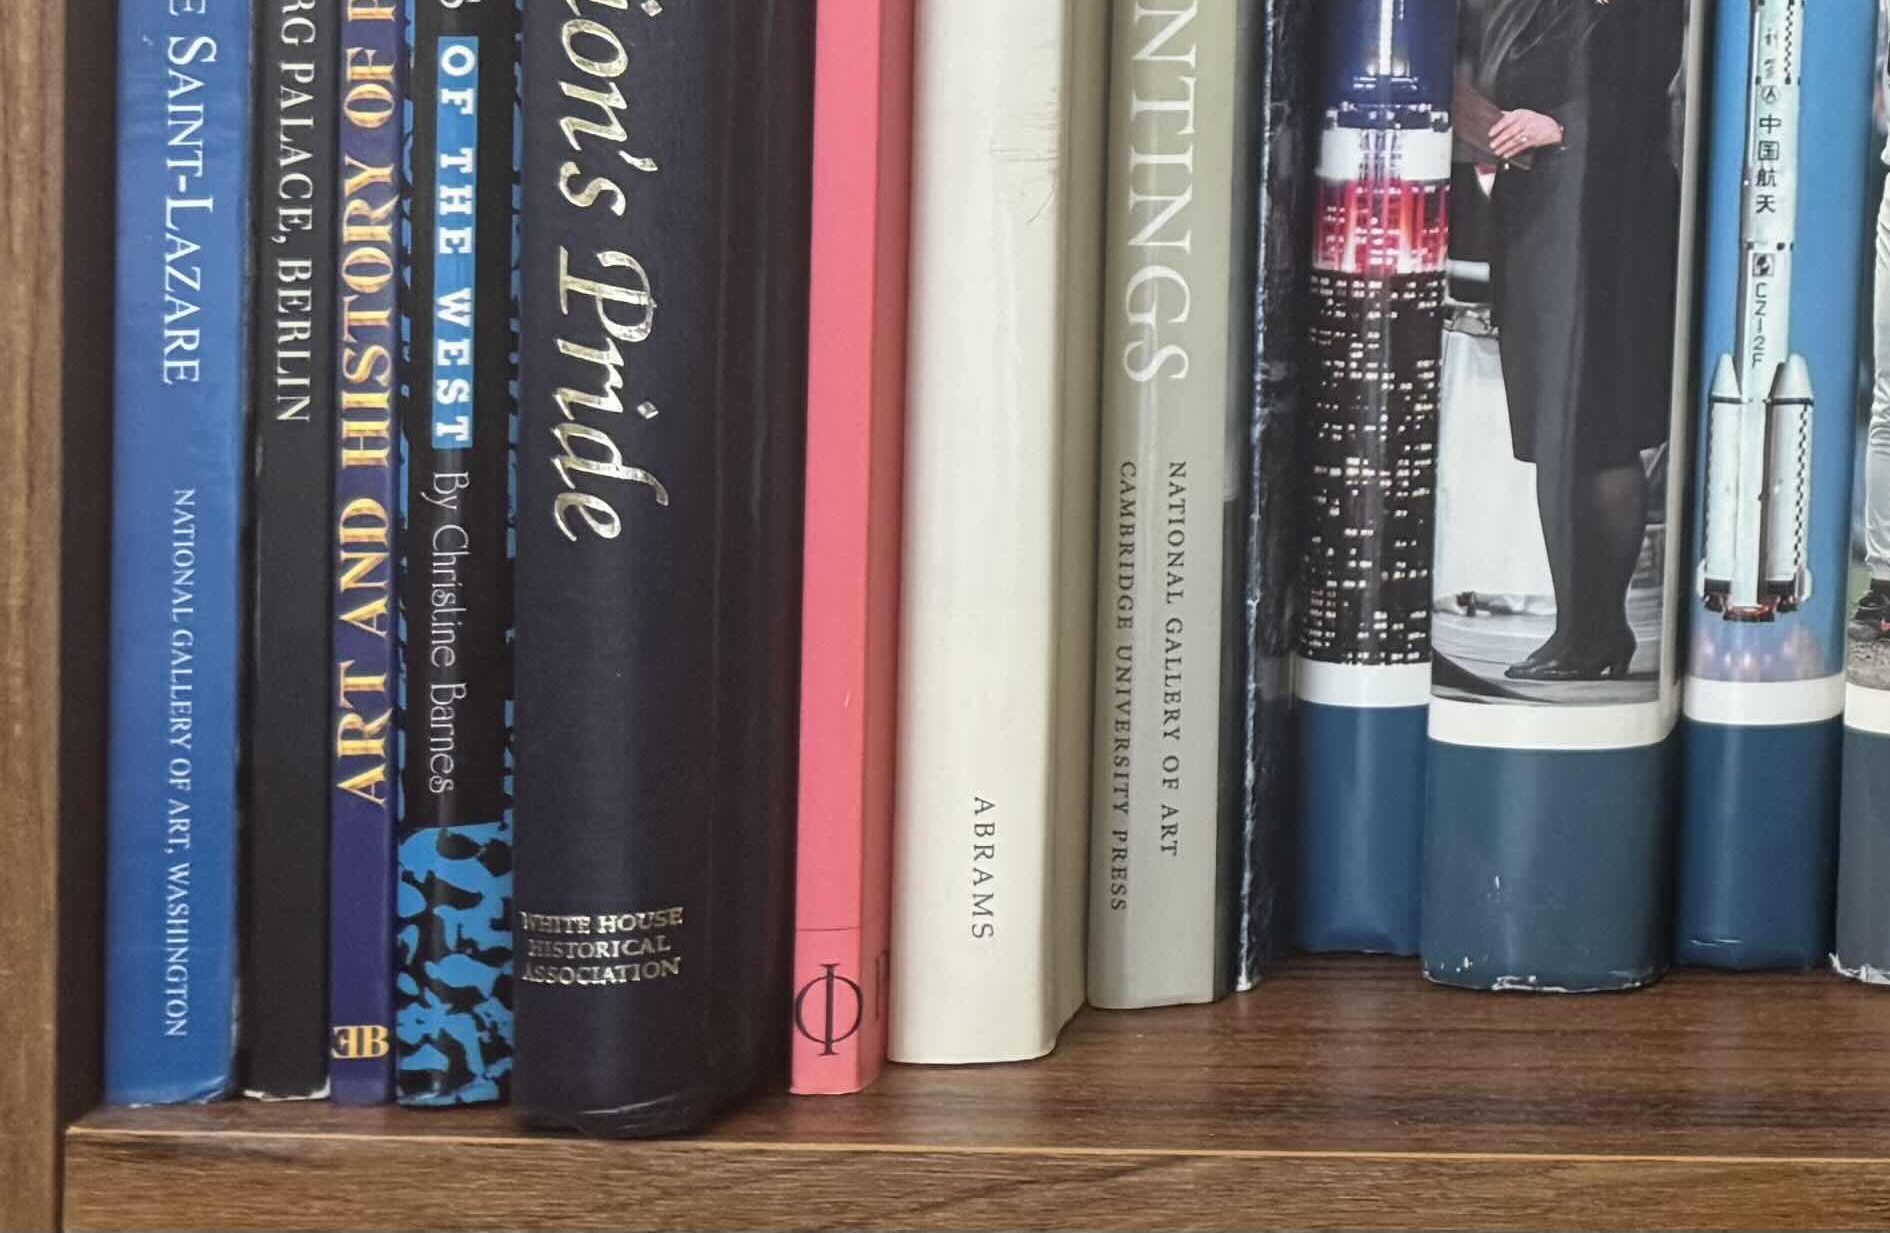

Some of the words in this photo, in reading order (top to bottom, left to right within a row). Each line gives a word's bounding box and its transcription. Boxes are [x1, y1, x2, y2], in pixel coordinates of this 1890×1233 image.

[275, 60, 316, 244] PALACE,
[1756, 114, 1781, 214] 中国航天
[276, 259, 313, 423] BERLIN
[551, 229, 670, 541] Pride
[172, 489, 195, 622] NATIONAL
[1118, 462, 1136, 630] CAMBRIDGE
[1167, 462, 1186, 604] NATIONAL
[169, 629, 194, 747] GALLERY
[1112, 645, 1132, 813] UNIVERSITY
[1163, 618, 1183, 740] GALLERY
[167, 798, 189, 855] ART,
[169, 759, 191, 789] OF
[1160, 804, 1178, 857] ART
[1162, 755, 1180, 790] OF
[973, 795, 995, 941] ABRAMS
[1111, 830, 1129, 911] PRESS
[163, 862, 189, 1037] WASHINGTON
